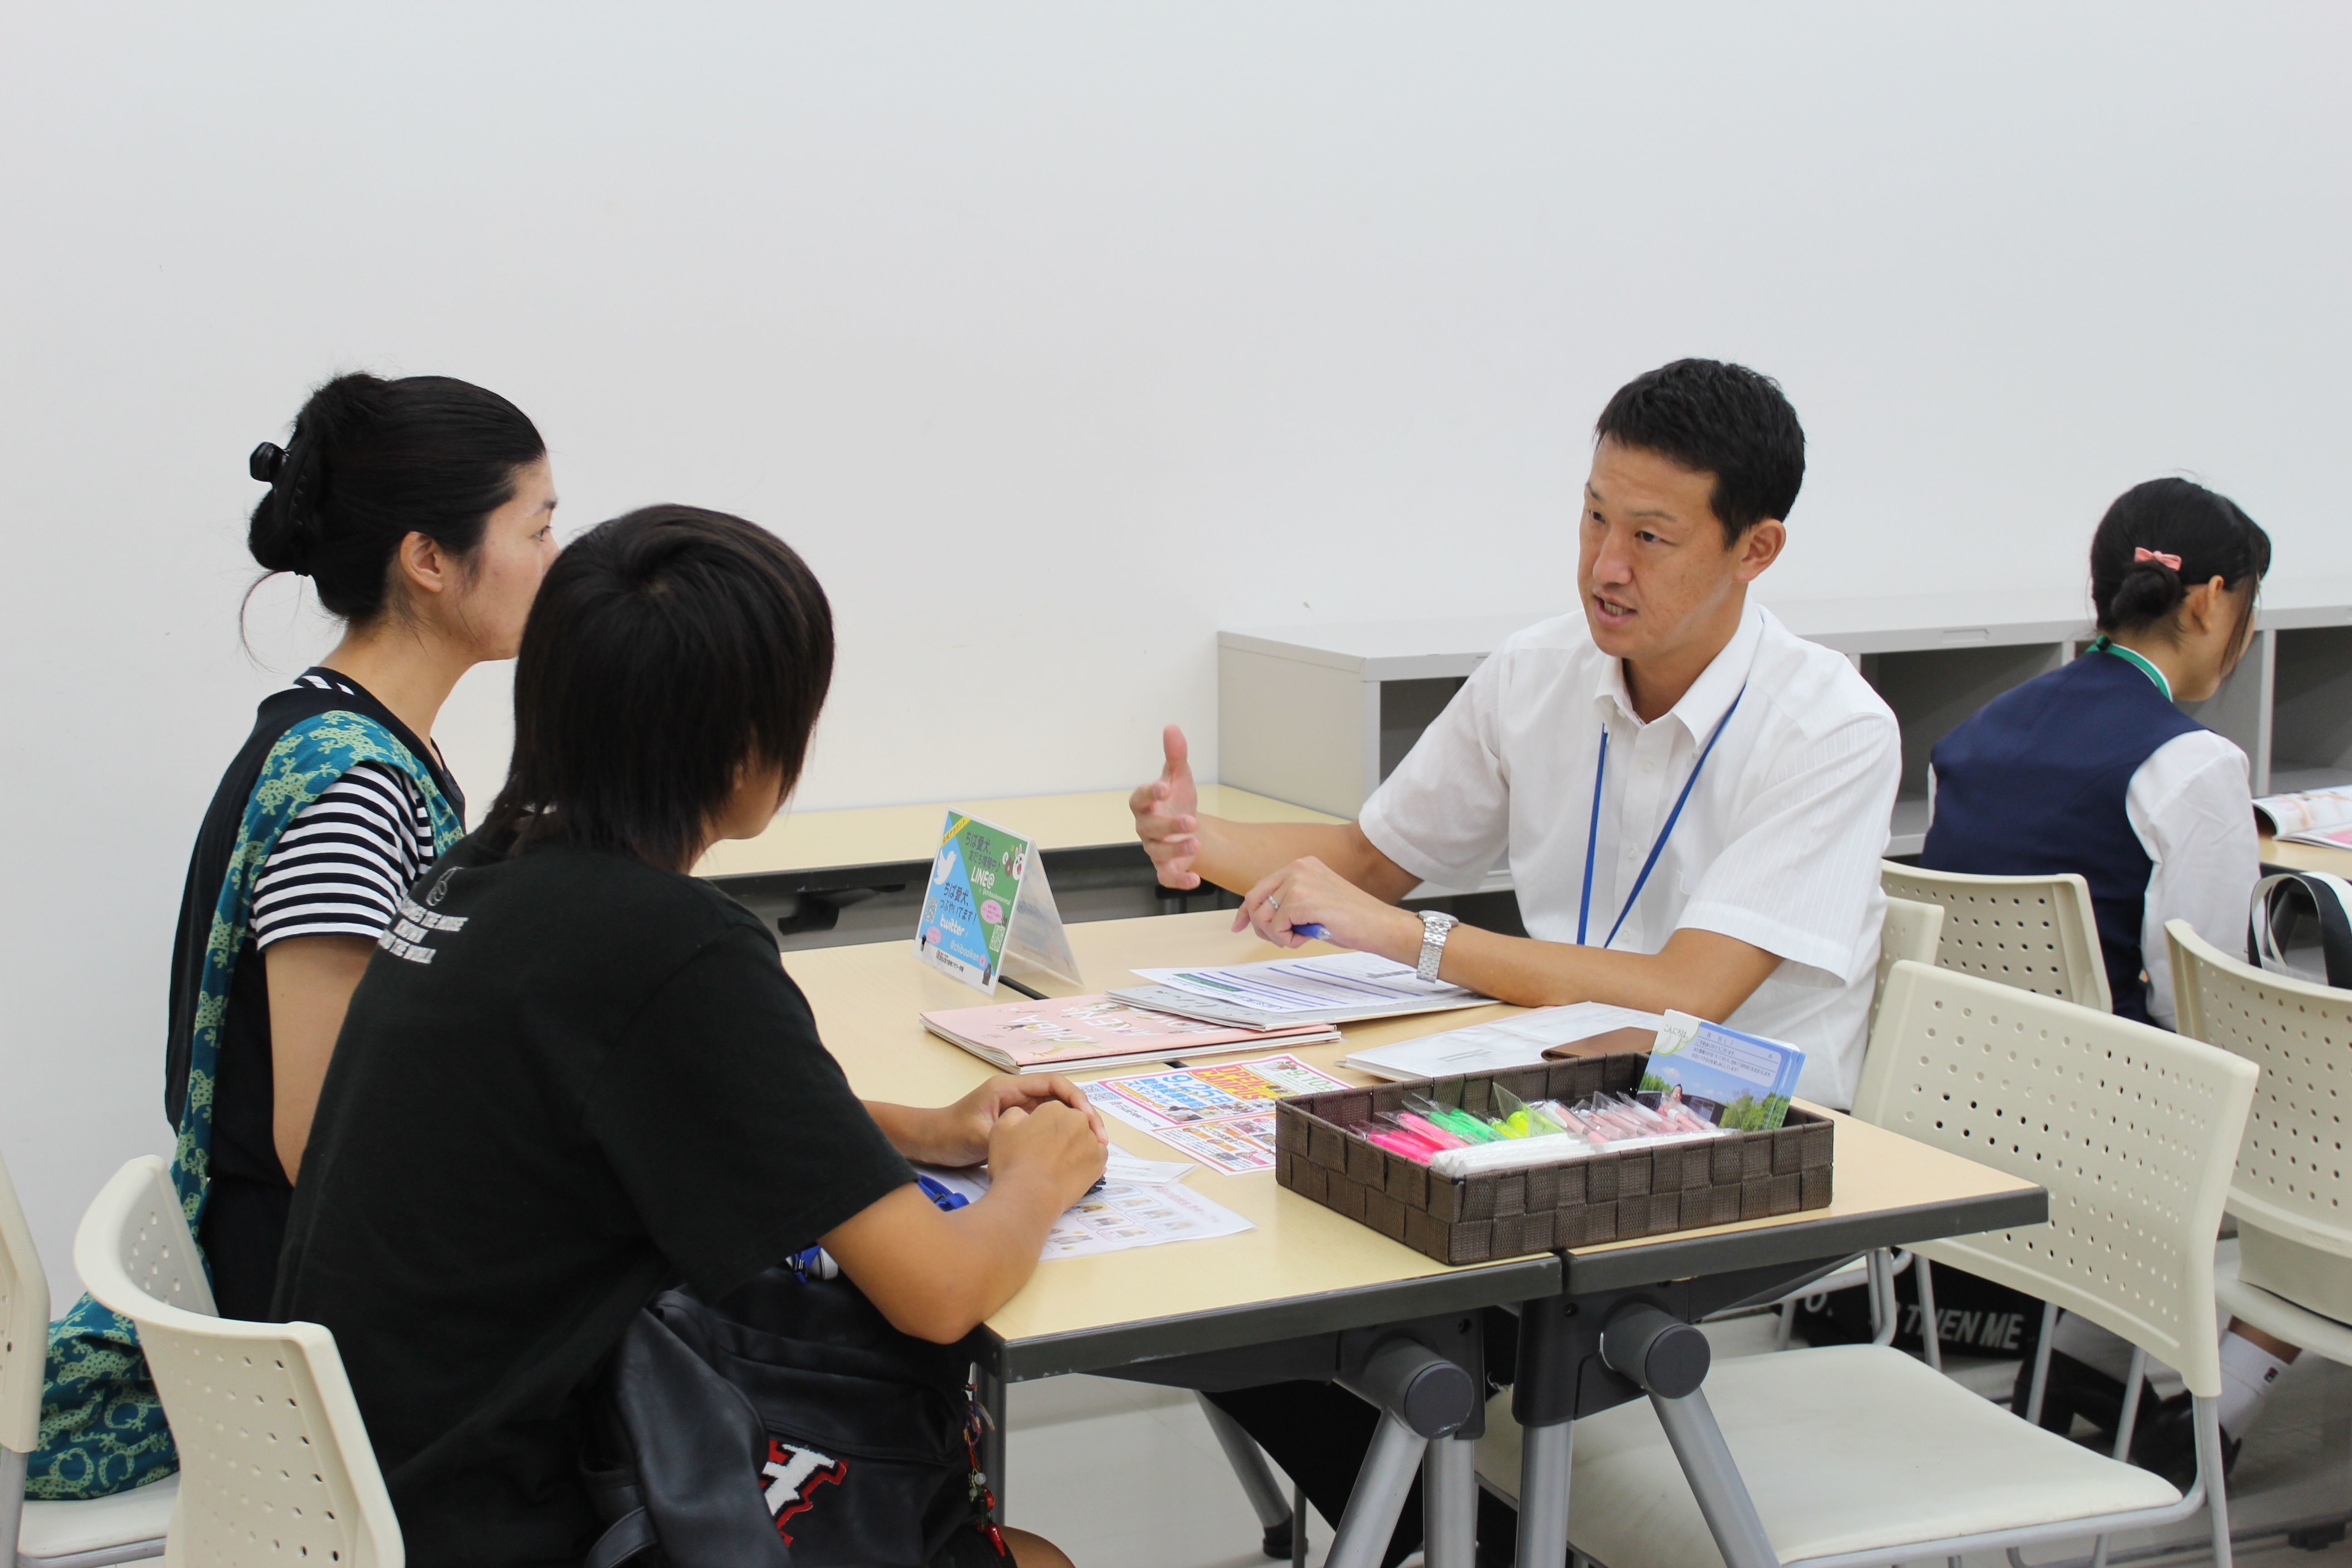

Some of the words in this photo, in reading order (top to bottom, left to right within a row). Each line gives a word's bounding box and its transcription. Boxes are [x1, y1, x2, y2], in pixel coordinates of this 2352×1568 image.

[970, 866, 995, 889] LINE@
[943, 882, 969, 906] ちば愛犬、
[940, 914, 965, 936] twitter
[1009, 1014, 1093, 1042] CHIBA
[1196, 1071, 1268, 1100] CAMPUS
[1220, 1065, 1271, 1087] OPEN
[1979, 1313, 2025, 1350] ME
